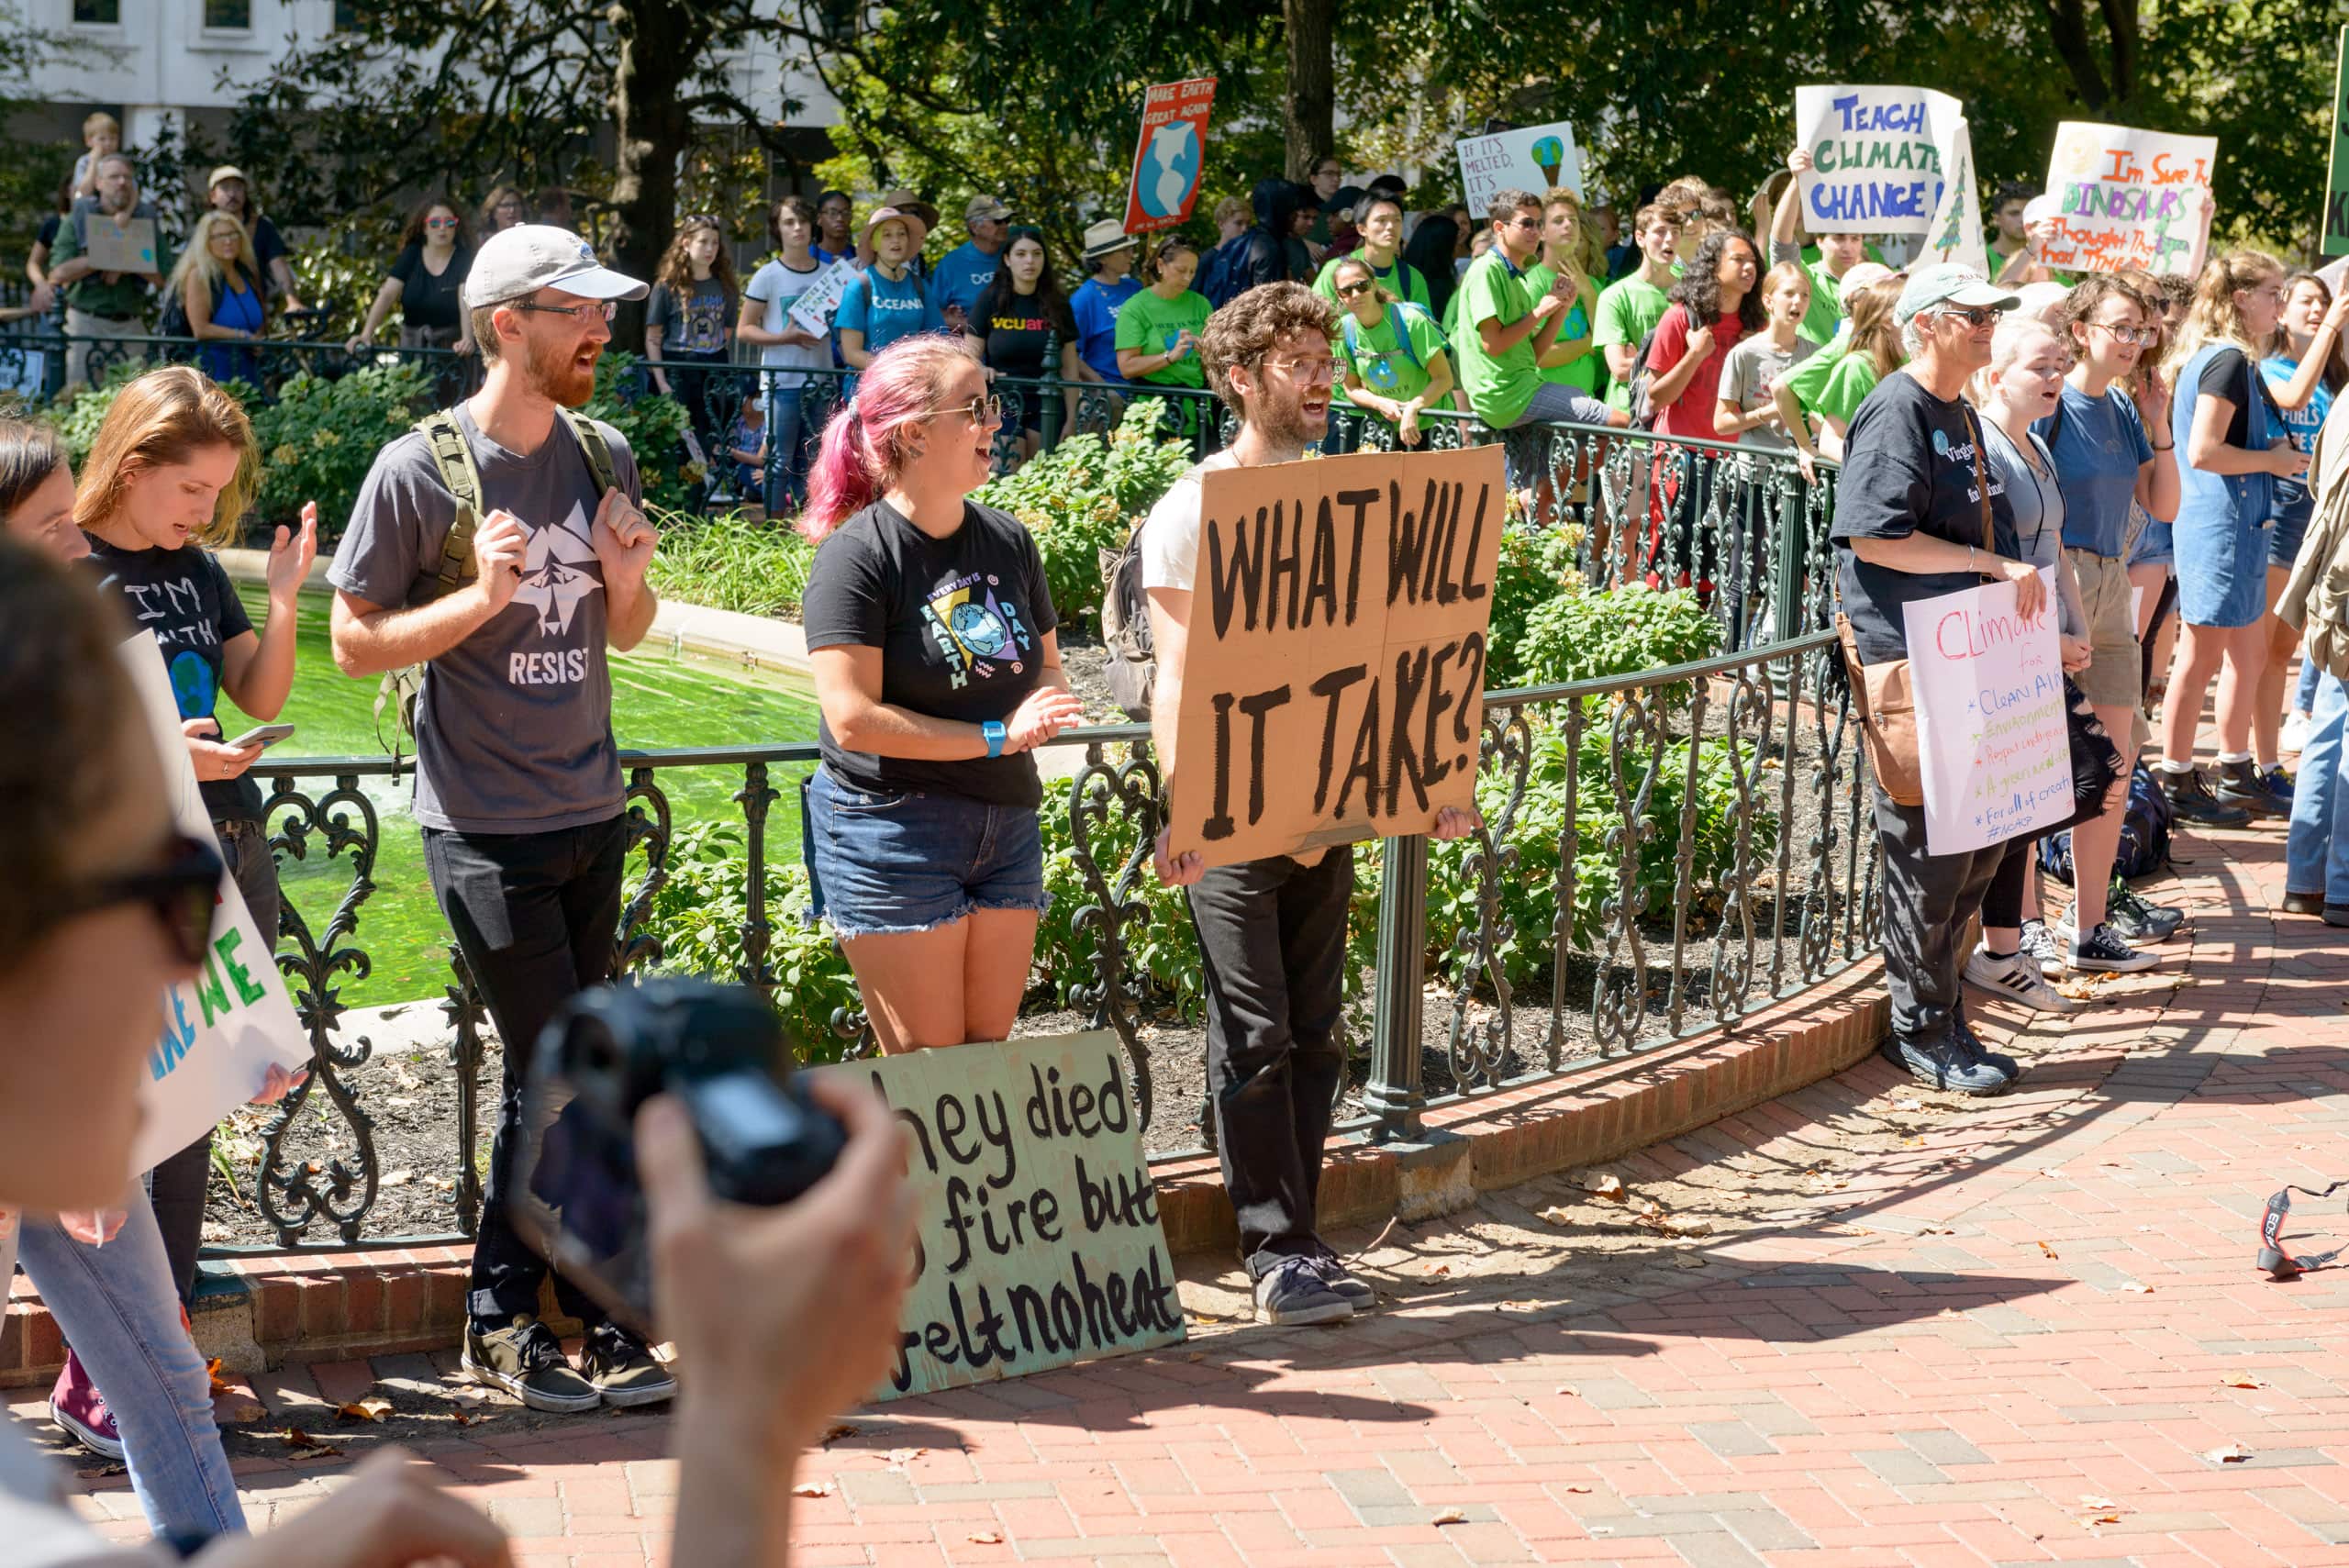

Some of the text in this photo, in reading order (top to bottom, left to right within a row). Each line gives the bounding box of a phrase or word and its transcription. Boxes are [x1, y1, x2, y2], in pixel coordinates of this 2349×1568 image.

[1148, 81, 1214, 104] MAKE EARTH
[1145, 102, 1209, 126] GREAT AGAIN
[1832, 93, 1926, 134] TEACH
[1464, 136, 1504, 158] IF IT'S
[1464, 153, 1514, 174] MELTED,
[1813, 139, 1943, 176] CLIMATE
[1467, 174, 1497, 194] IT'S
[2061, 181, 2195, 222] DINOSAURS
[2281, 406, 2321, 427] FUELS
[1208, 477, 1489, 642] WHAT WILL
[125, 577, 202, 620] I'M
[926, 572, 981, 603] EVERY DAY IS
[1000, 601, 1030, 651] DAY
[919, 604, 969, 691] EARTH
[1200, 629, 1485, 841] IT TAKE?
[871, 1051, 1130, 1190] hey died
[943, 1175, 1063, 1274] fire
[1074, 1153, 1161, 1234] but
